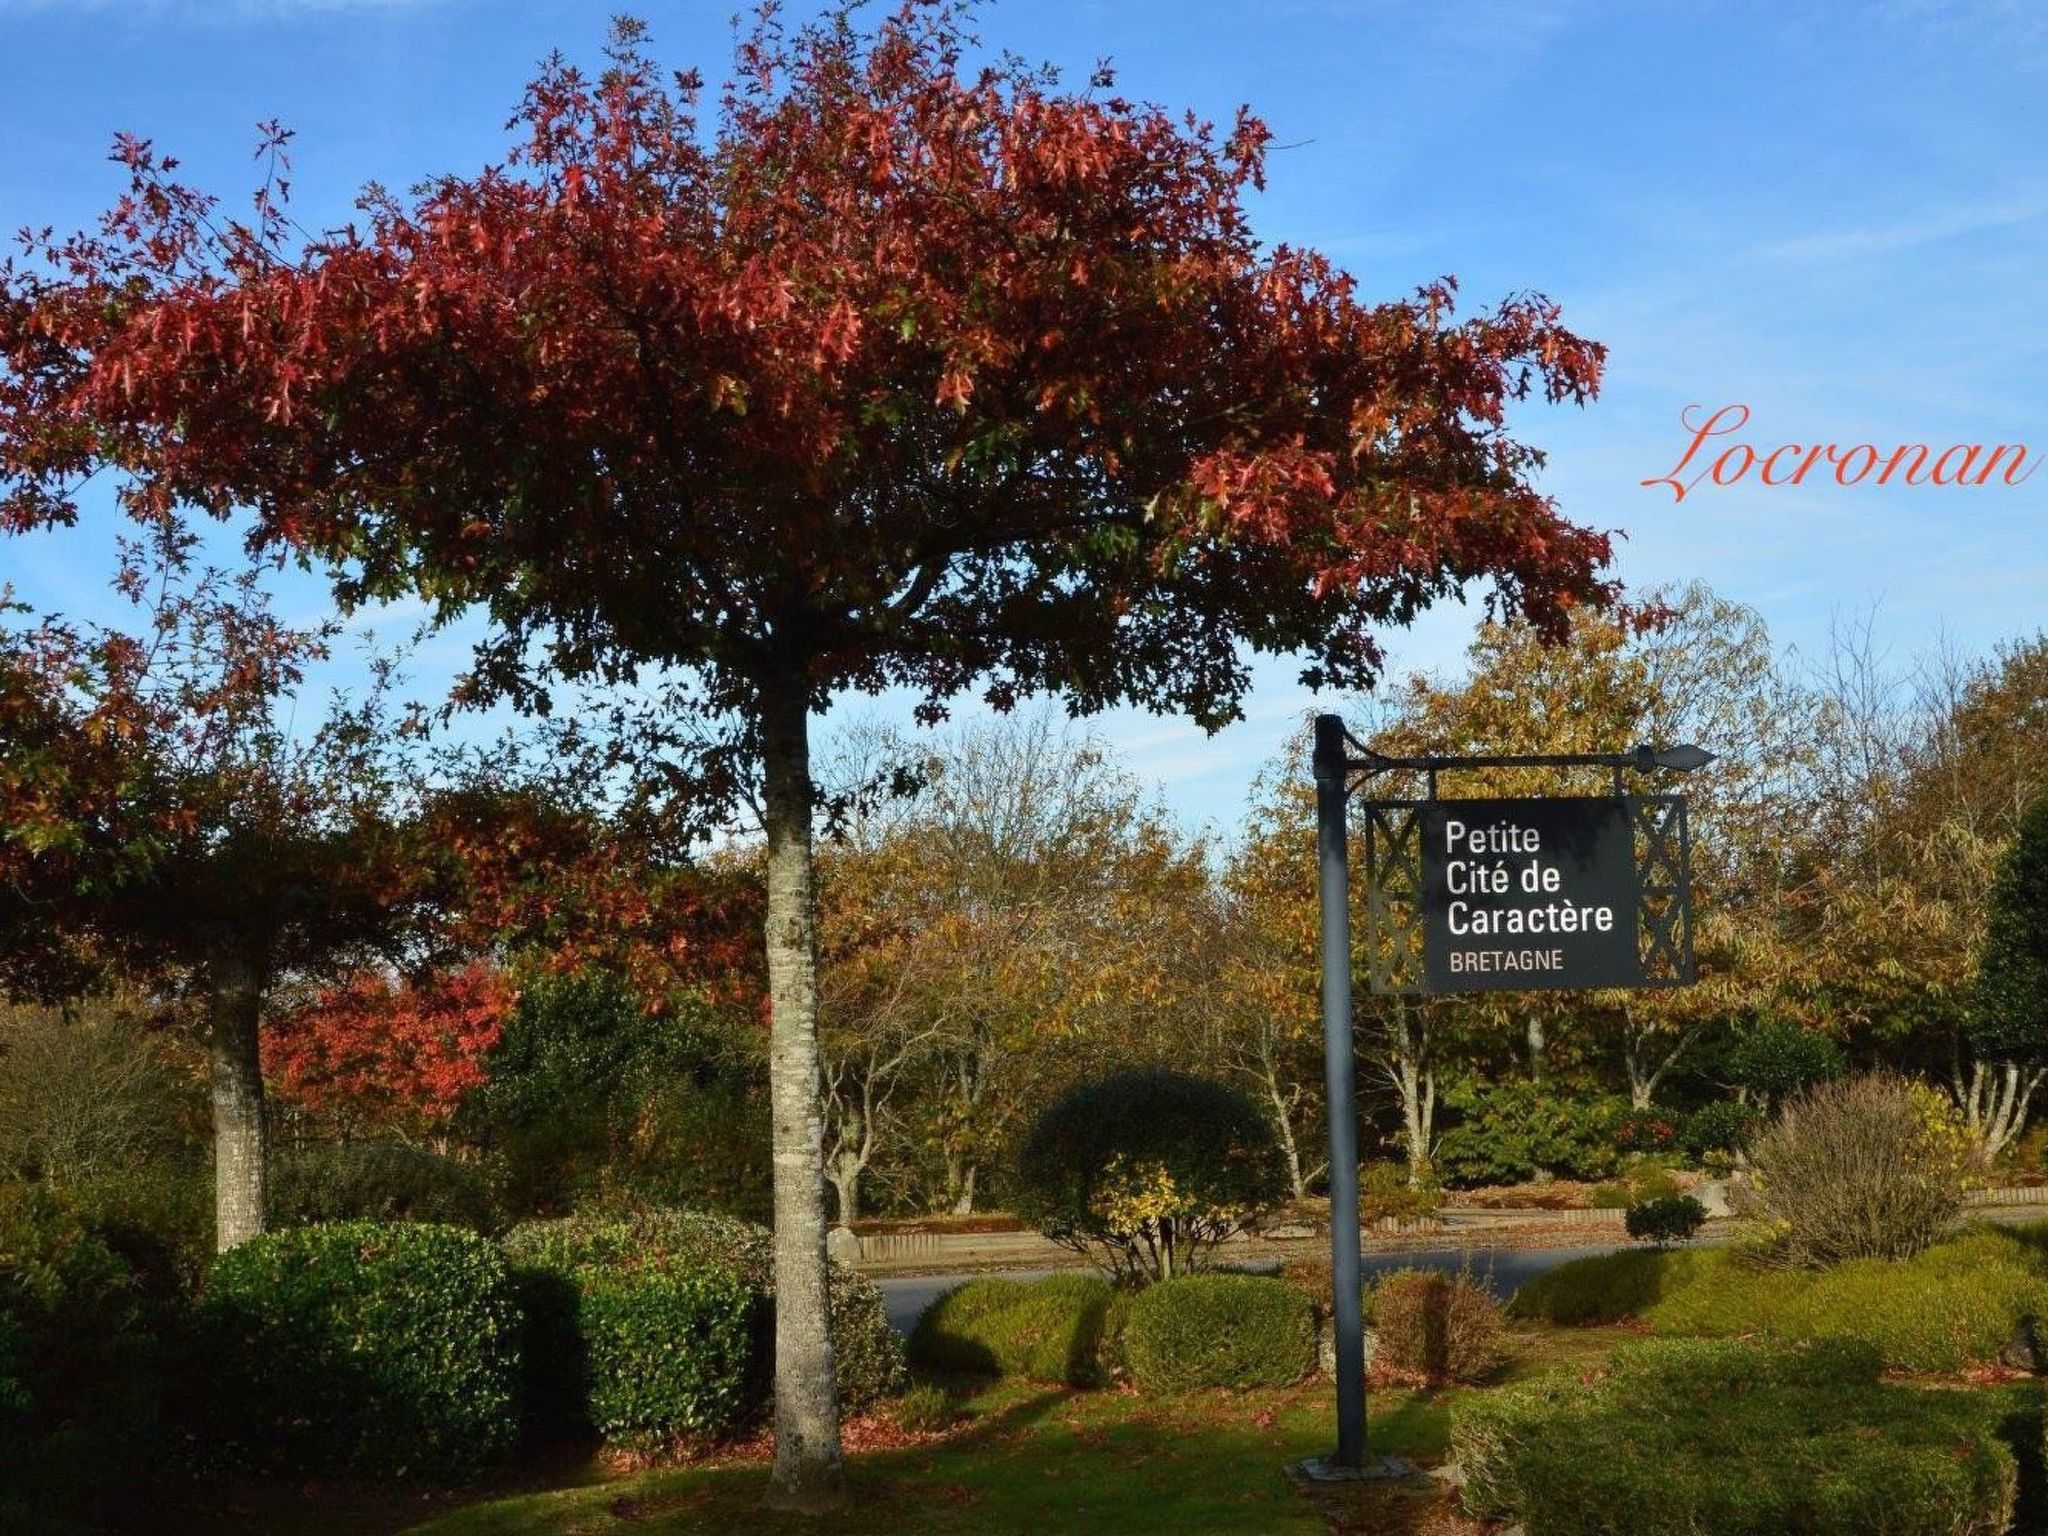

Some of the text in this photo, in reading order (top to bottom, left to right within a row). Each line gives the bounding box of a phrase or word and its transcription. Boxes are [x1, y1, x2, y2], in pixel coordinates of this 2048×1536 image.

[1445, 820, 1541, 855] Petite
[1445, 858, 1562, 895] Cité de
[1447, 898, 1614, 936] Caractère
[1449, 949, 1564, 973] BRETAGNE
